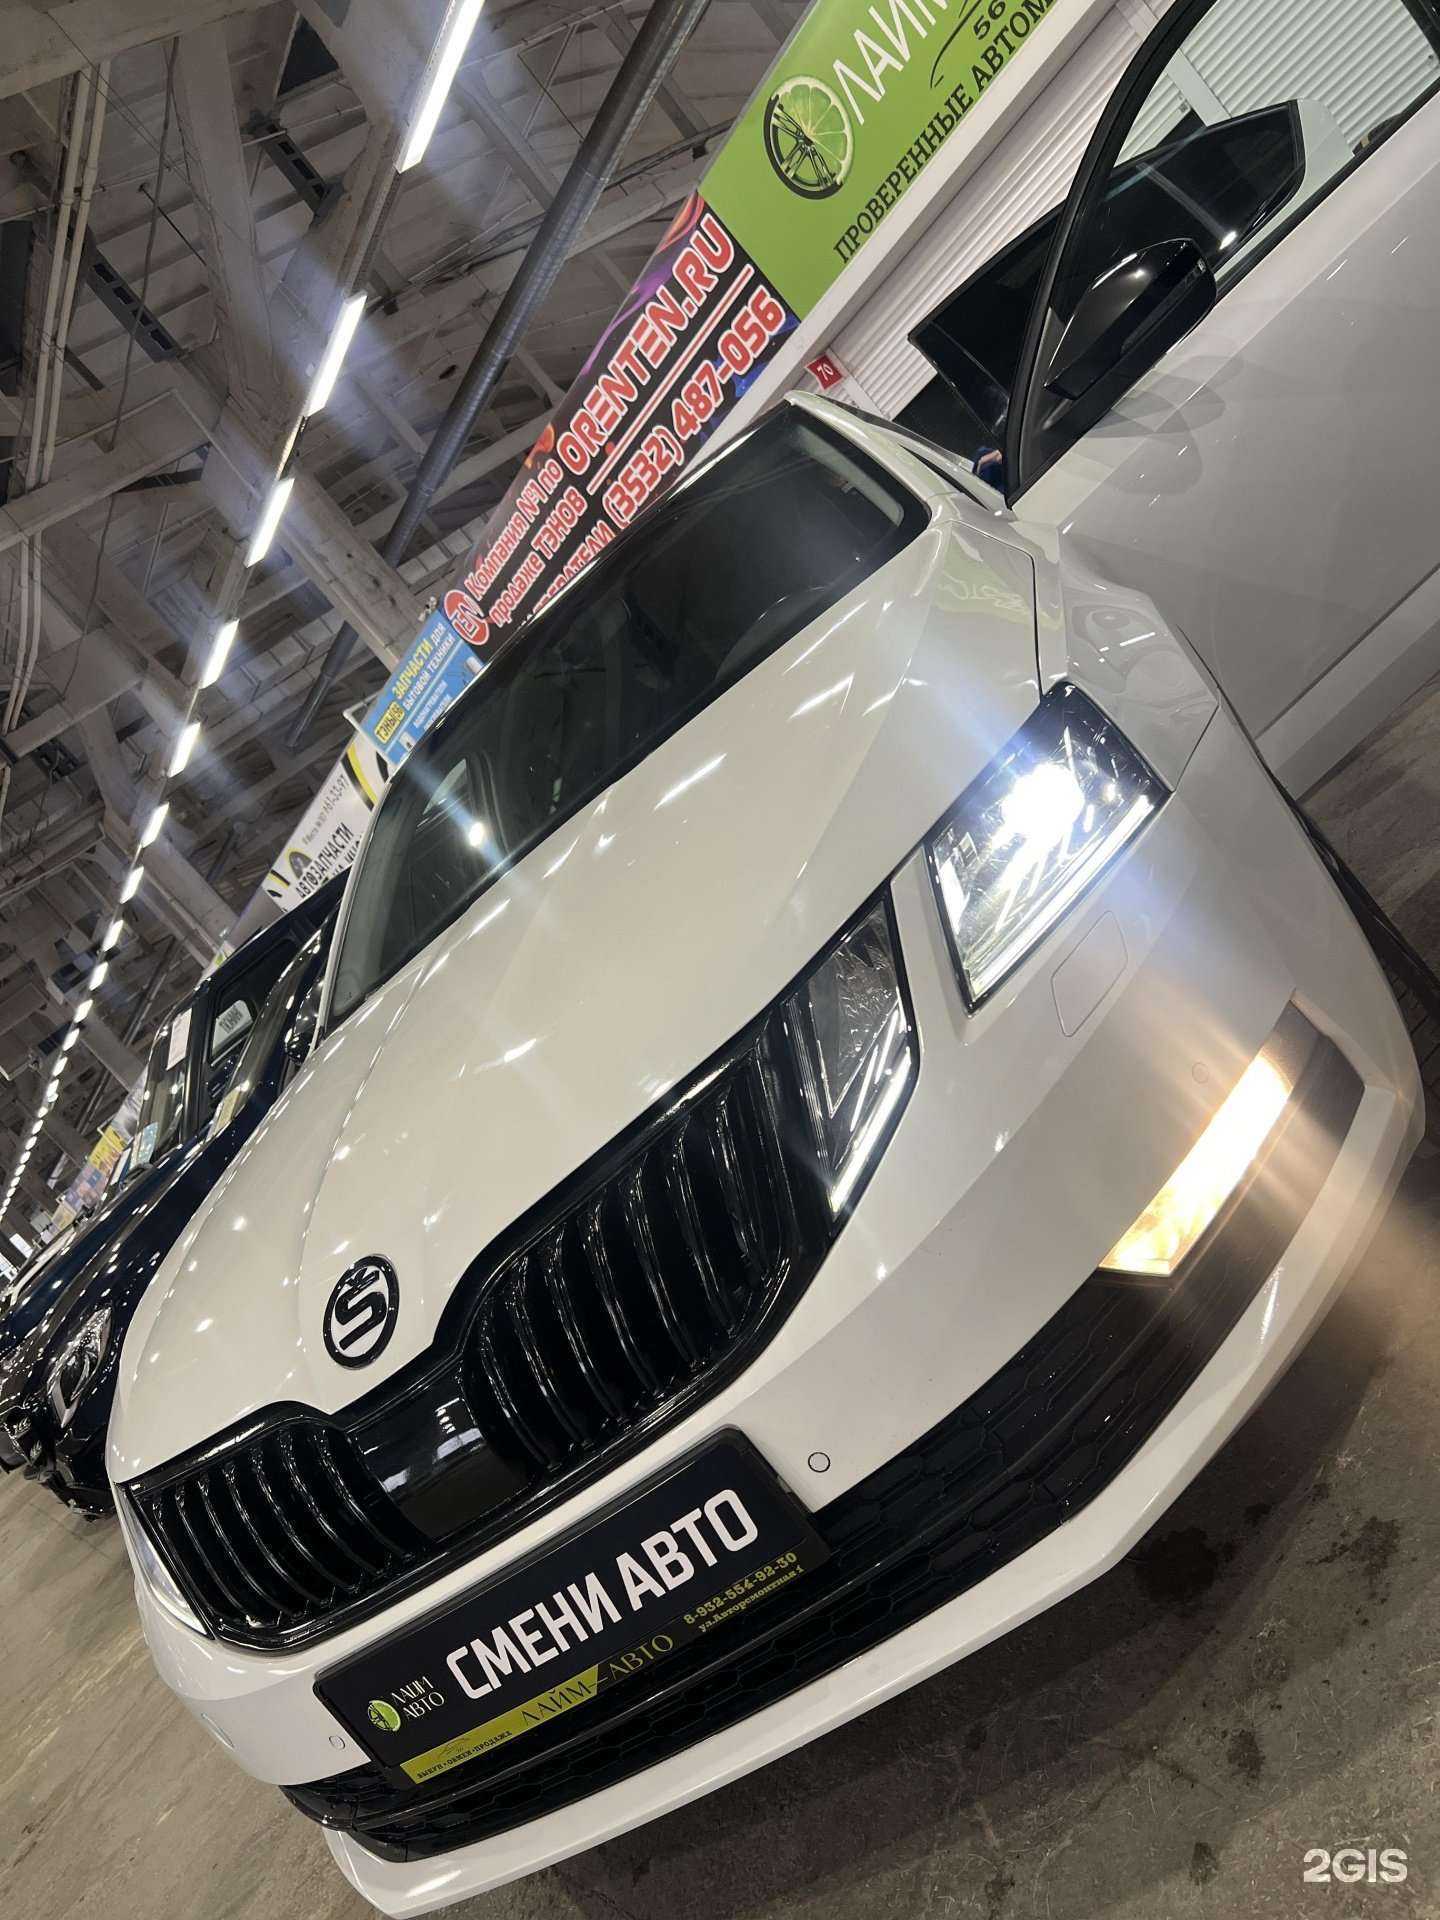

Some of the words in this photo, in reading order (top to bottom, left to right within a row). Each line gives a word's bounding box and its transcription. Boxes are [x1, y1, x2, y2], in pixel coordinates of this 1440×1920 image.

[833, 83, 974, 264] ПРОВЕРЕННЫЕ
[557, 213, 734, 475] ORENTEN.RU
[602, 426, 685, 530] (3532)
[672, 284, 786, 440] 487-056
[817, 363, 834, 381] 70
[464, 511, 531, 602] Компания
[516, 478, 549, 523] №1
[538, 459, 564, 496] по
[489, 551, 546, 627] продаже
[531, 486, 588, 560] ТЭНОВ
[392, 637, 434, 699] ЗАПЧАСТИ
[426, 632, 456, 673] ТЕХНИКИ
[446, 1572, 623, 1700] СМЕНИ
[616, 1489, 759, 1613] АВТО
[683, 1552, 798, 1625] 8-932-554-92-30
[402, 1691, 445, 1720] АВТО
